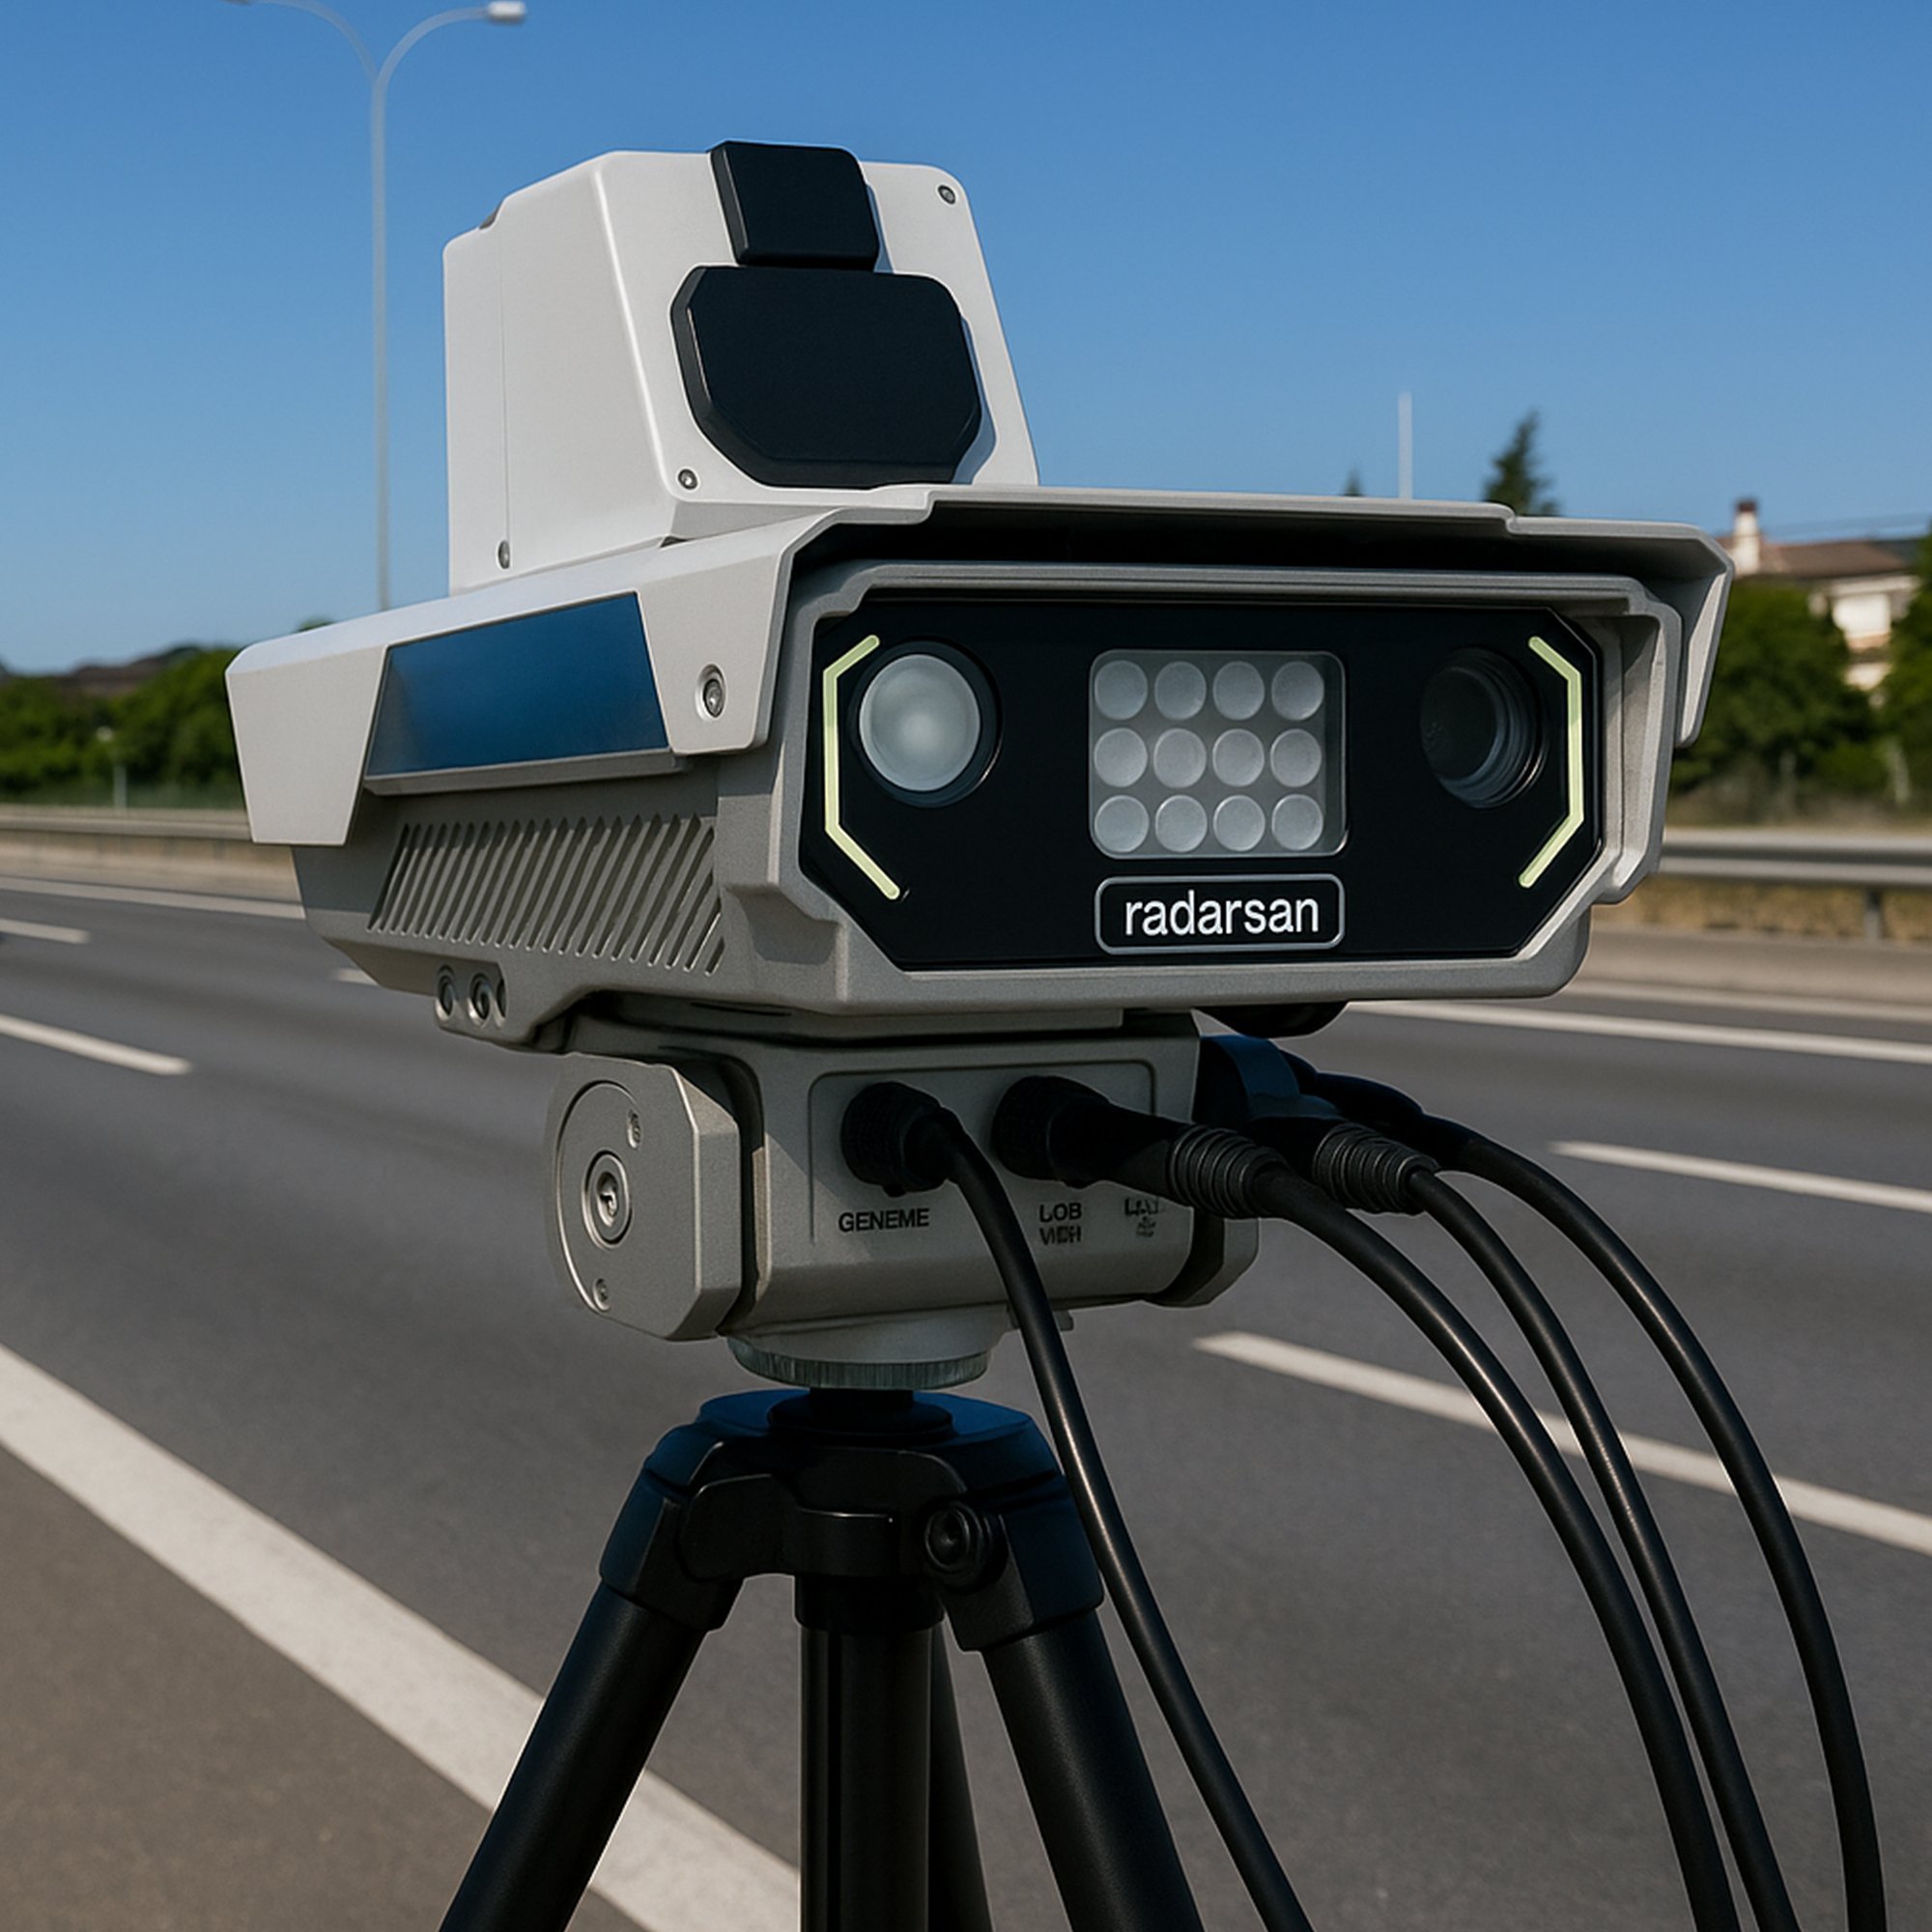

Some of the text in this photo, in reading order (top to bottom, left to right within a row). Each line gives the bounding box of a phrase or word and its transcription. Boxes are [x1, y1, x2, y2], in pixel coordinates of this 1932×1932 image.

[1125, 889, 1320, 936] radarsan
[838, 1208, 930, 1233] GENEME
[1039, 1203, 1082, 1223] LOB
